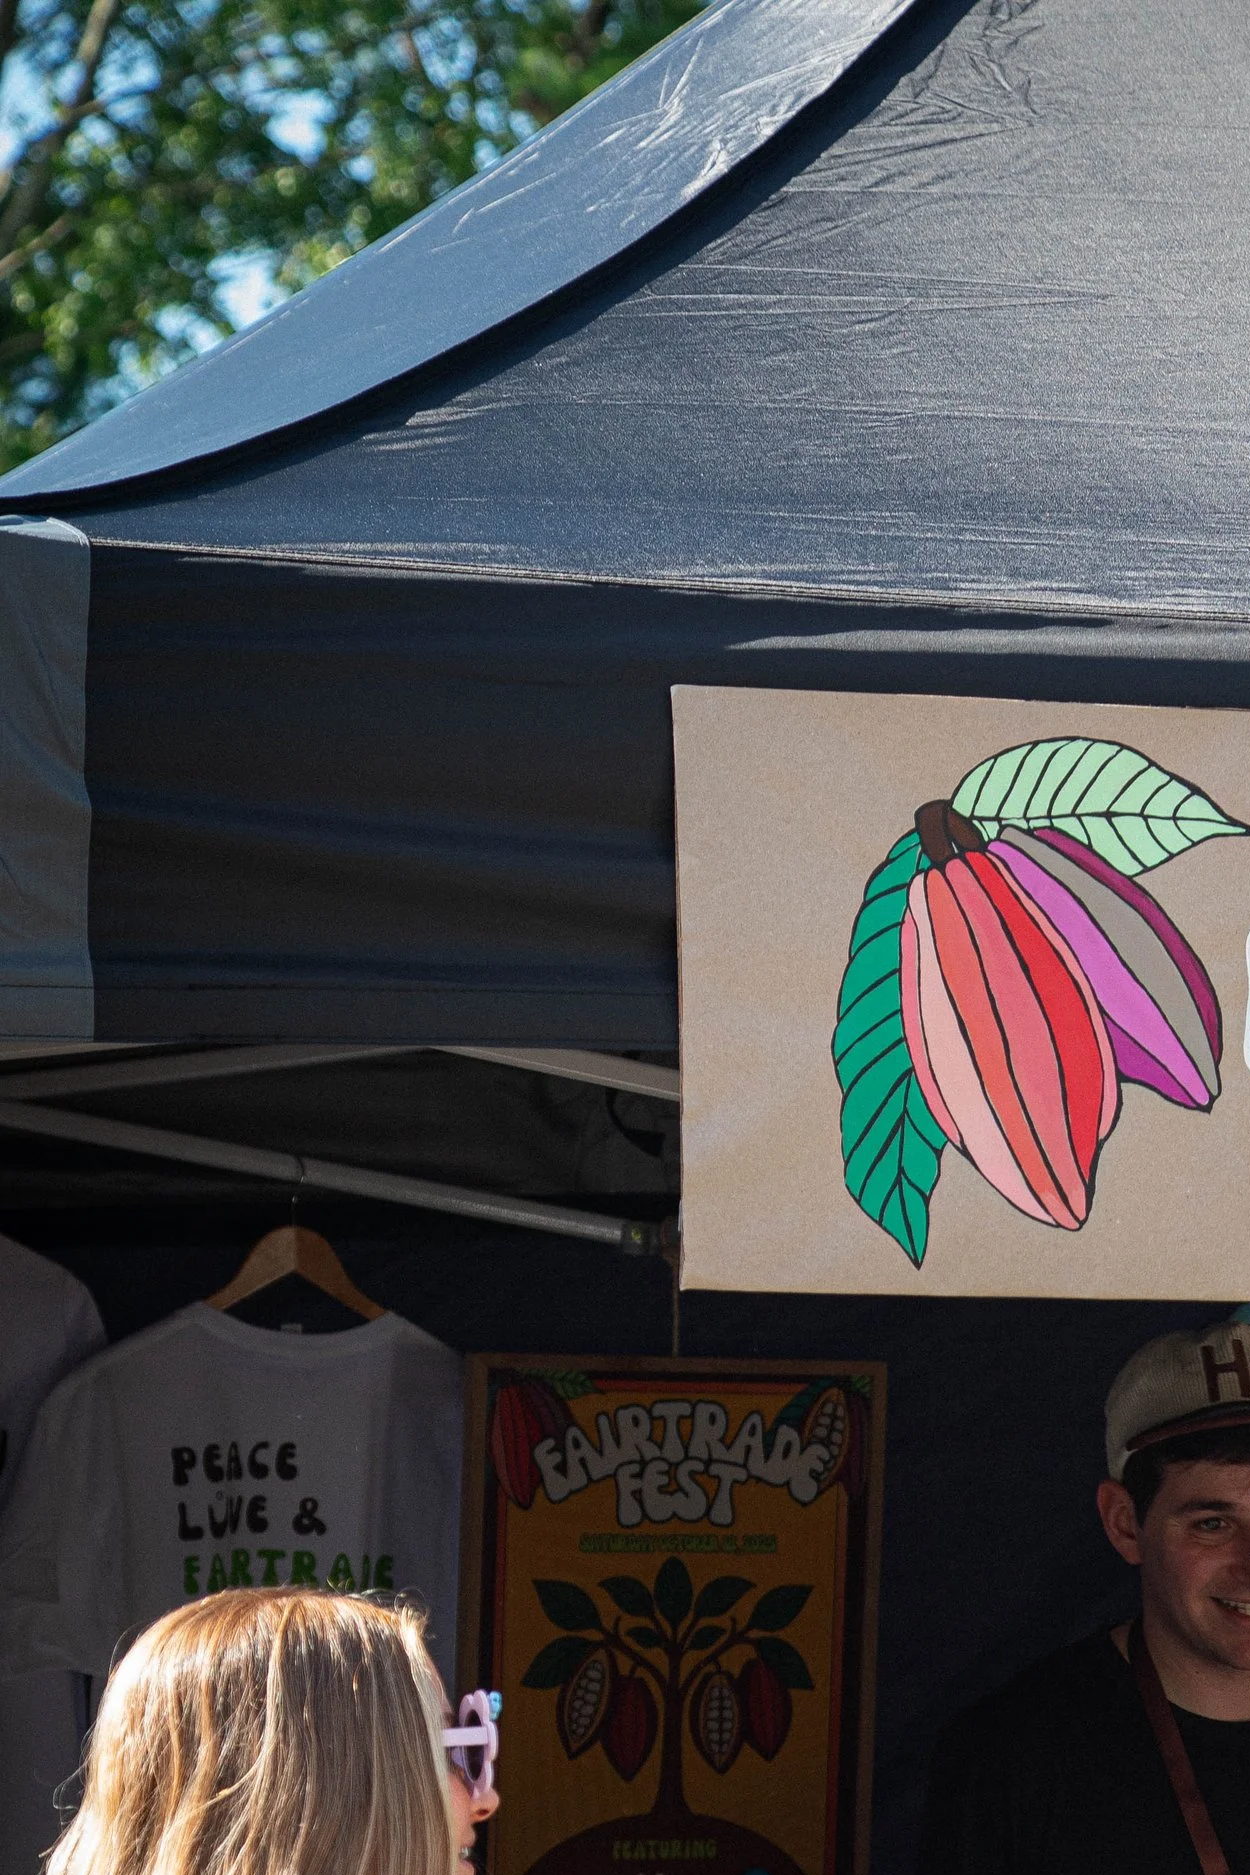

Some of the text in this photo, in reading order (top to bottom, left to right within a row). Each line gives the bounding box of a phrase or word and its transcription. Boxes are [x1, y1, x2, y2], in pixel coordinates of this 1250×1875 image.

[171, 1440, 298, 1486] PEACE
[532, 1399, 834, 1508] FAIRTRADE
[292, 1497, 327, 1536] &
[613, 1458, 749, 1529] FEST
[612, 1839, 718, 1861] FEATURING
